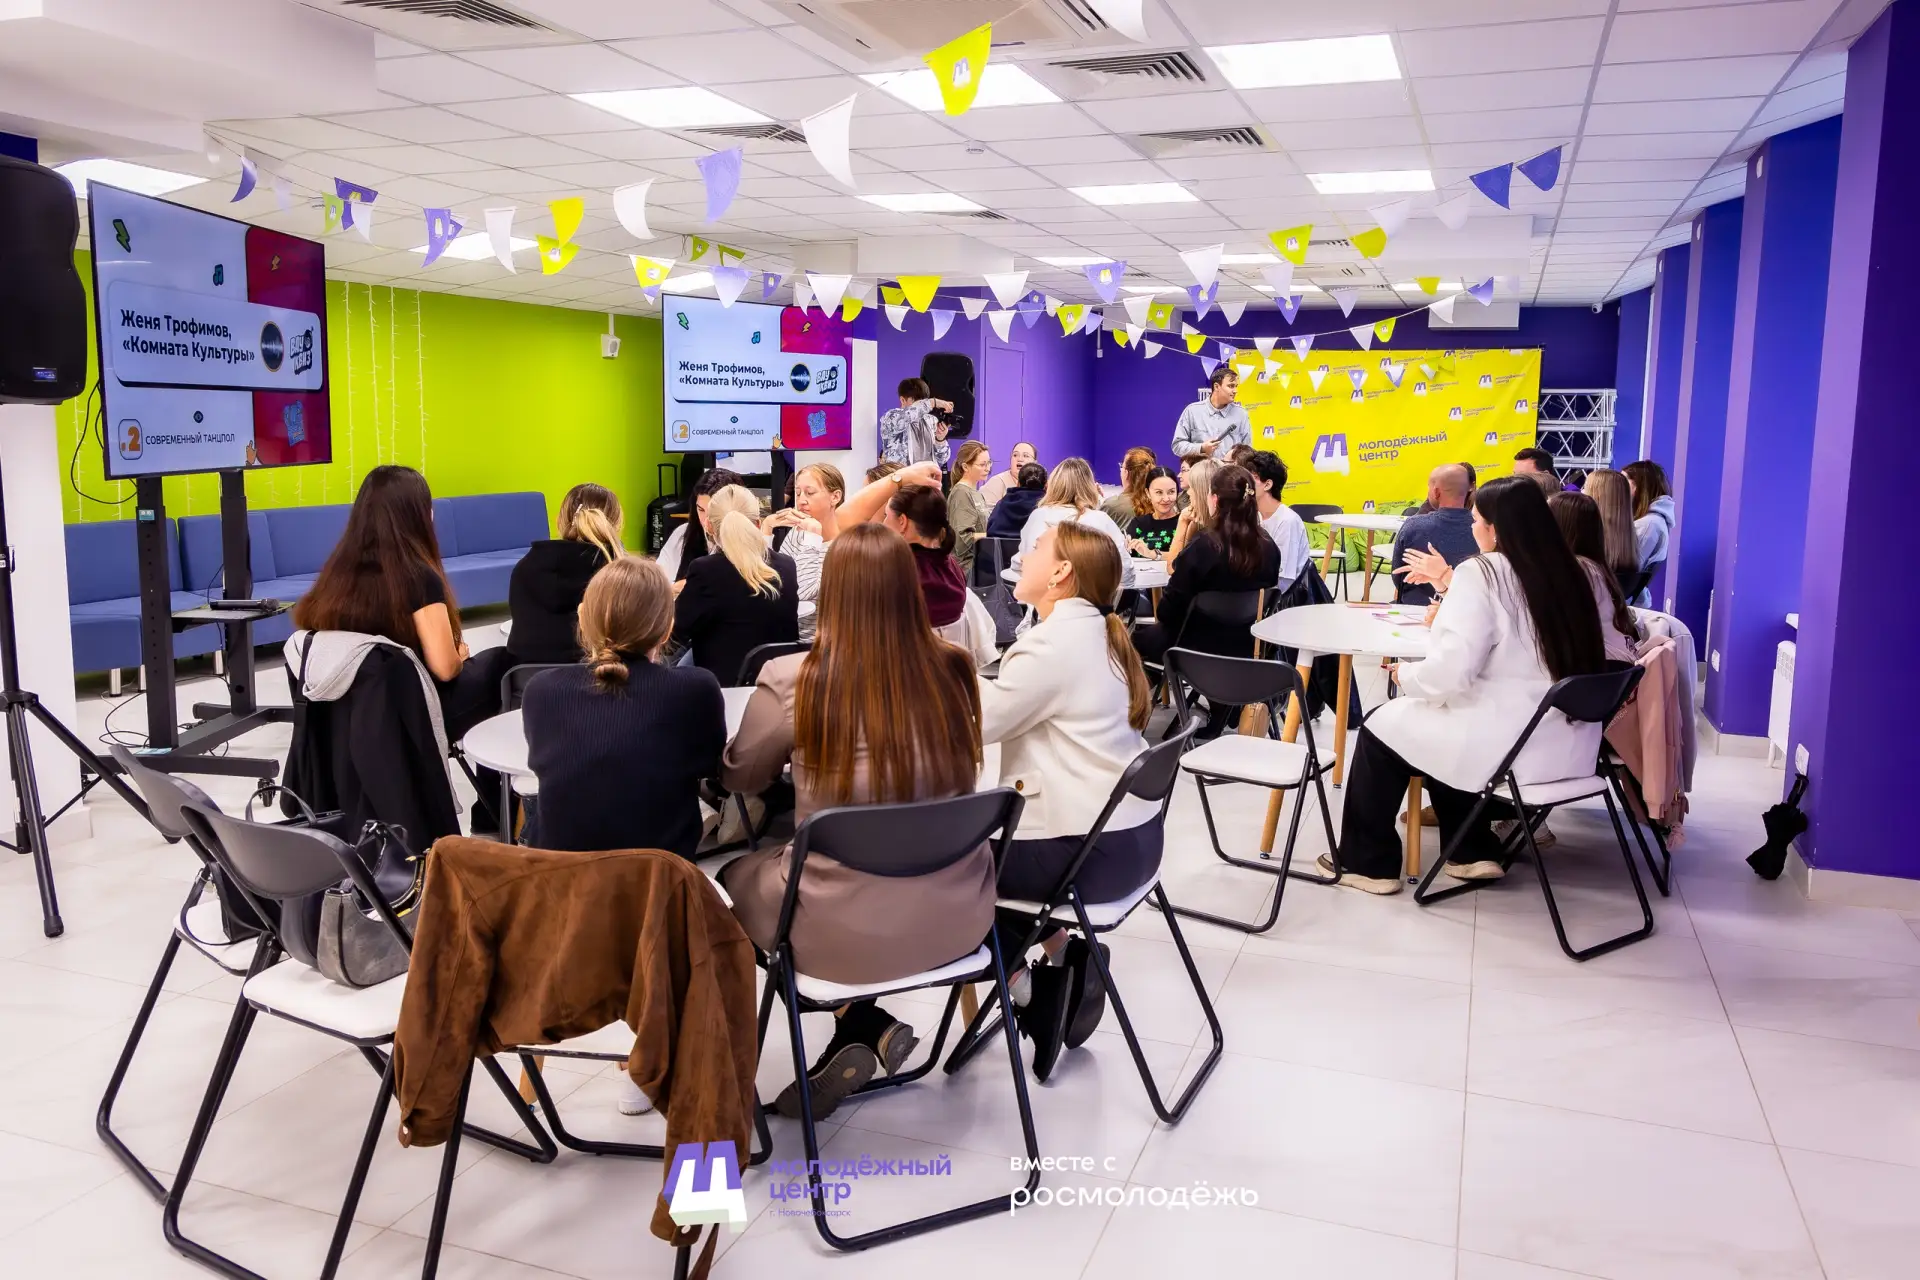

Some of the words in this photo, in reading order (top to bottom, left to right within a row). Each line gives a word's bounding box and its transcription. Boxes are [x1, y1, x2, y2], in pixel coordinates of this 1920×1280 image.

[120, 309, 161, 331] Женя
[164, 315, 232, 340] Трофимов,
[123, 335, 189, 358] «Комната
[192, 341, 255, 364] Культуры»
[679, 361, 709, 372] Женя
[711, 362, 765, 375] Трофимов,
[679, 375, 730, 386] «Комната
[731, 376, 784, 389] Культуры»
[145, 432, 201, 445] СОВРЕМЕННЫЙ
[203, 433, 236, 444] ТАНЦПОЛ
[692, 428, 737, 436] СОВРЕМЕННЫЙ
[1358, 430, 1448, 451] молодёжный
[1358, 449, 1400, 462] центр
